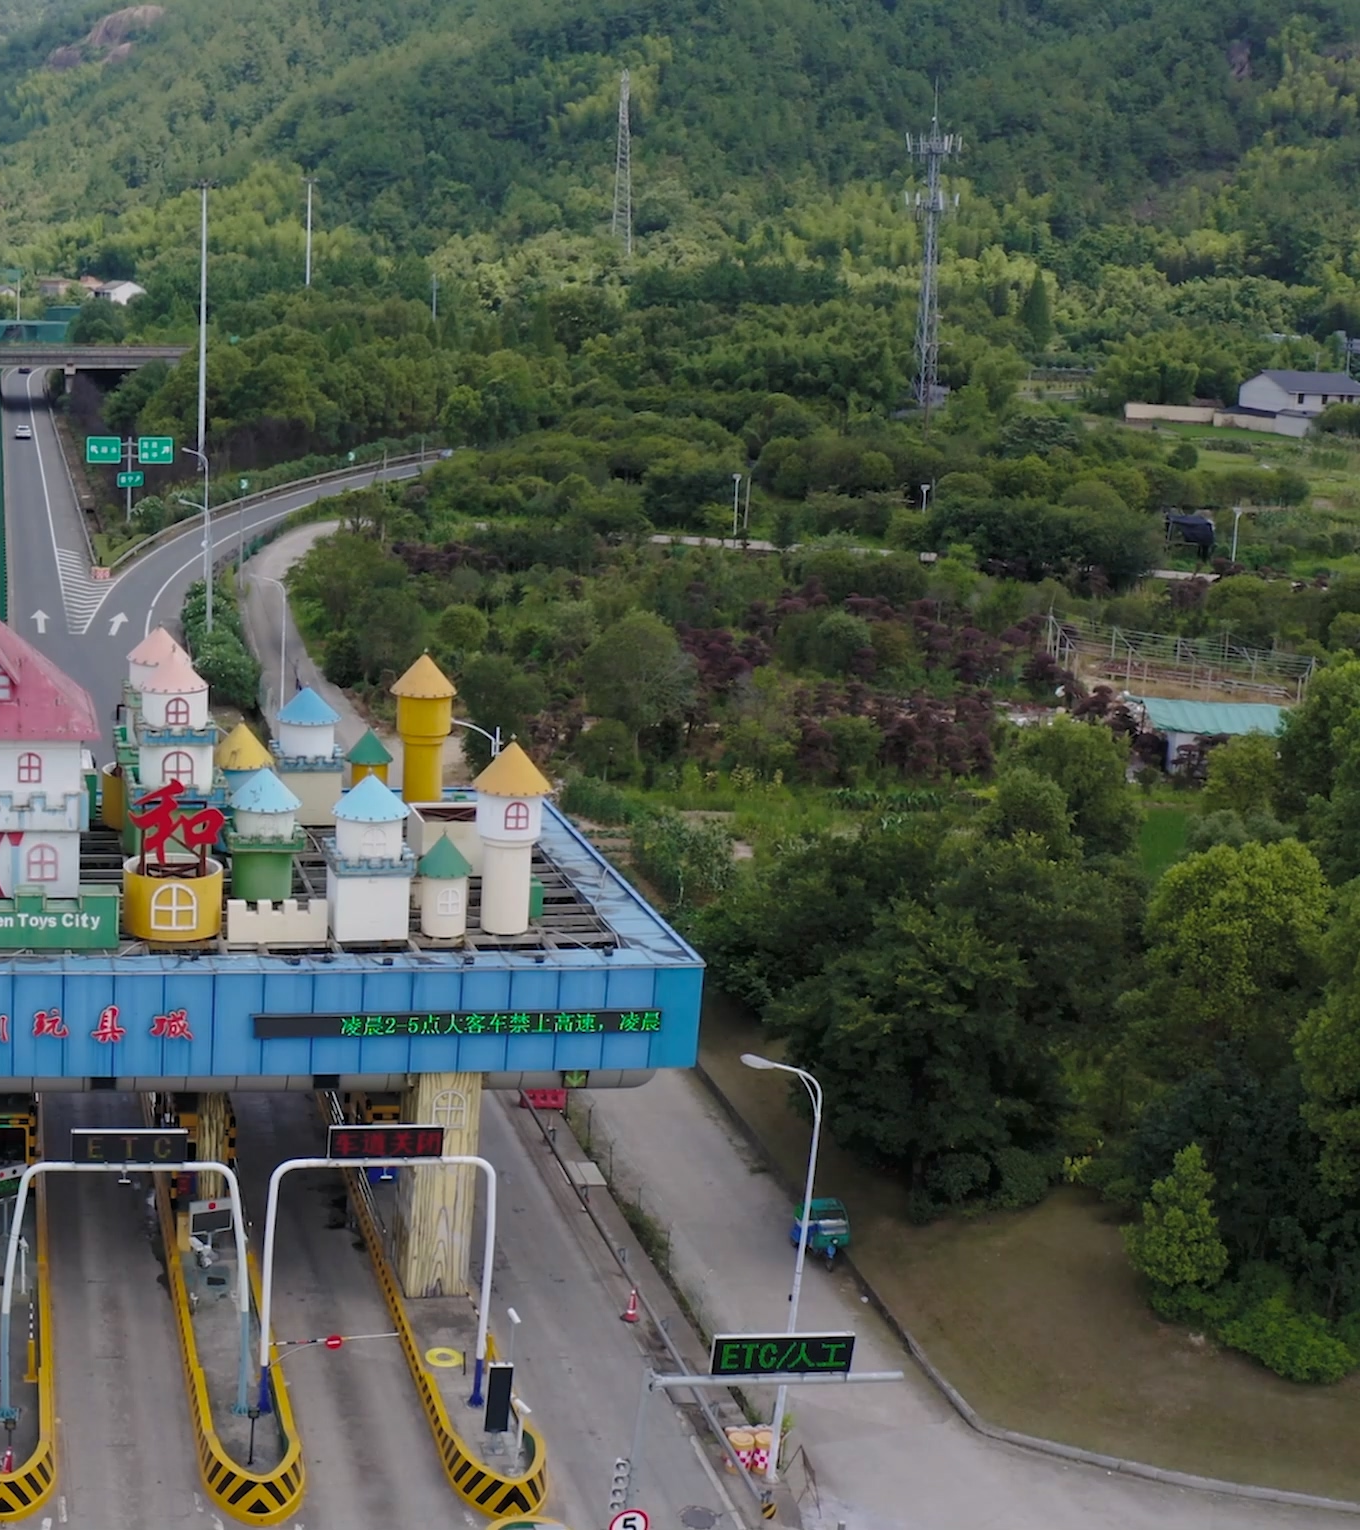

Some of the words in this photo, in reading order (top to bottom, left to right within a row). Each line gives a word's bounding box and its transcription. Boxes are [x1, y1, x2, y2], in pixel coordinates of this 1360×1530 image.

[130, 780, 224, 864] 和
[17, 913, 57, 930] Toys
[61, 912, 100, 930] City
[87, 1137, 171, 1158] ETC
[720, 1342, 846, 1370] ETC/人工
